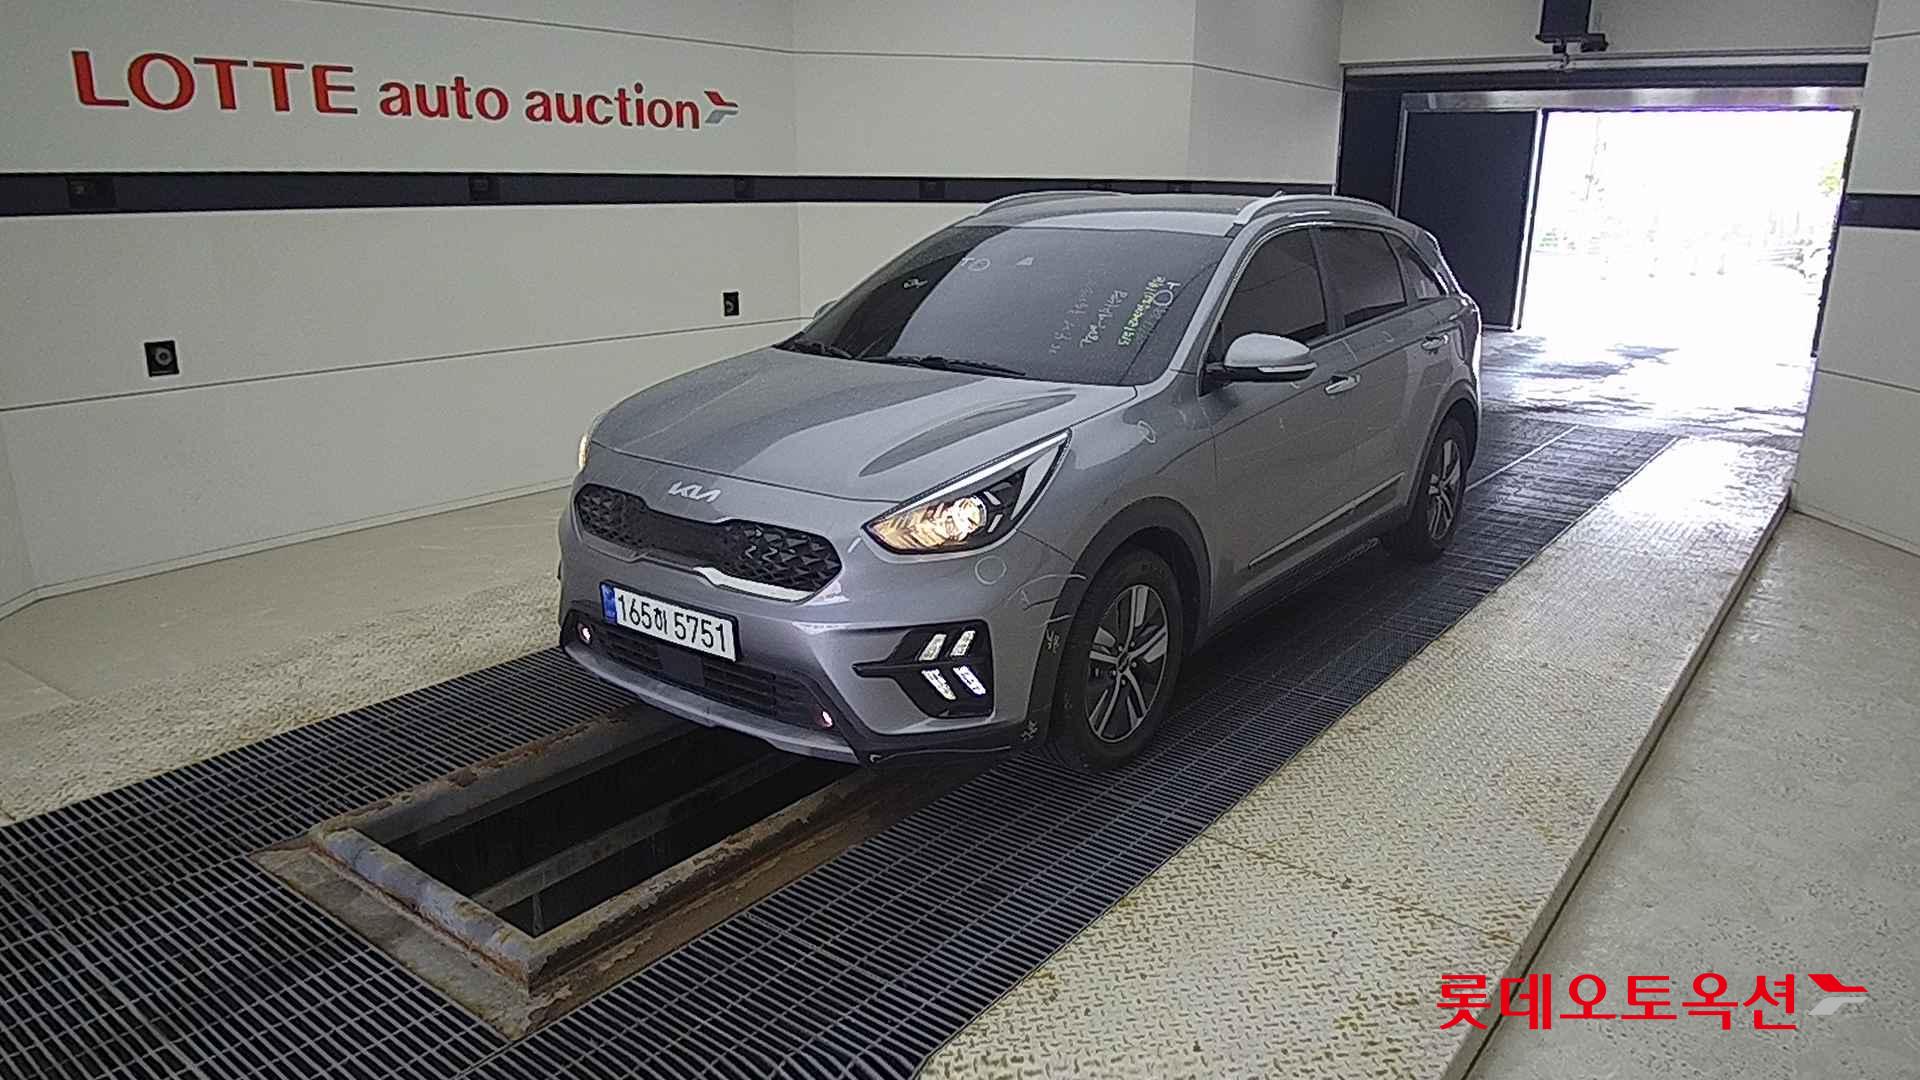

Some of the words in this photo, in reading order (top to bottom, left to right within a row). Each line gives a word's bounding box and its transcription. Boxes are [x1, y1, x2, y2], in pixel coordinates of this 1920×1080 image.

[71, 50, 358, 115] LOTTE
[379, 77, 510, 121] auto
[524, 82, 701, 130] auction
[674, 612, 726, 653] 5751
